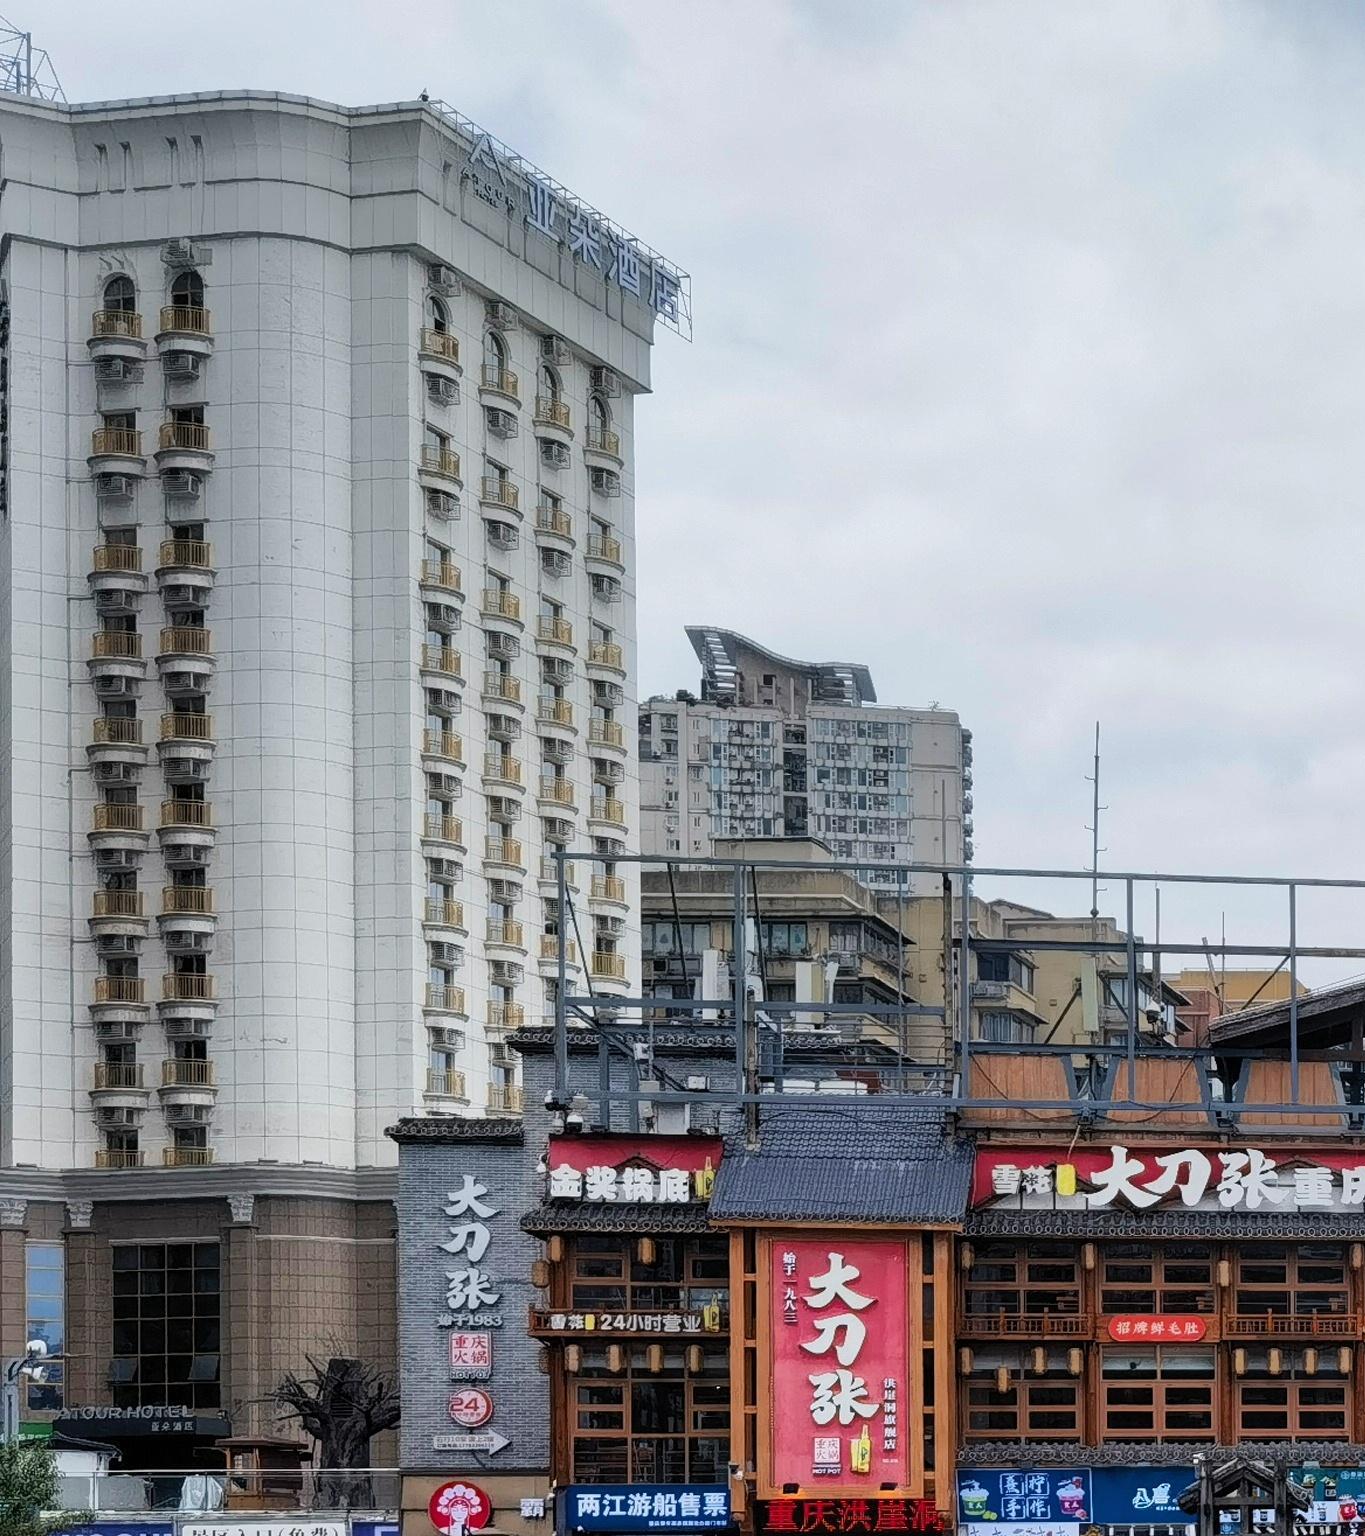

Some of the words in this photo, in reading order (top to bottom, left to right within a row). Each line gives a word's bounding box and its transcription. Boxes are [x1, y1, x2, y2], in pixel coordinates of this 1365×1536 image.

[524, 171, 679, 324] 亚朵酒店
[551, 1164, 690, 1203] 金奖锅底
[439, 1174, 500, 1310] 大刀张
[783, 1252, 798, 1324] 始于一九八三
[600, 1314, 702, 1332] 24小时营业
[453, 1335, 487, 1349] 重庆
[801, 1252, 880, 1425] 大刀张
[454, 1350, 487, 1364] 火锅
[127, 1405, 194, 1419] HOTEL
[451, 1397, 480, 1412] 24
[575, 1492, 728, 1518] 两江游船售票
